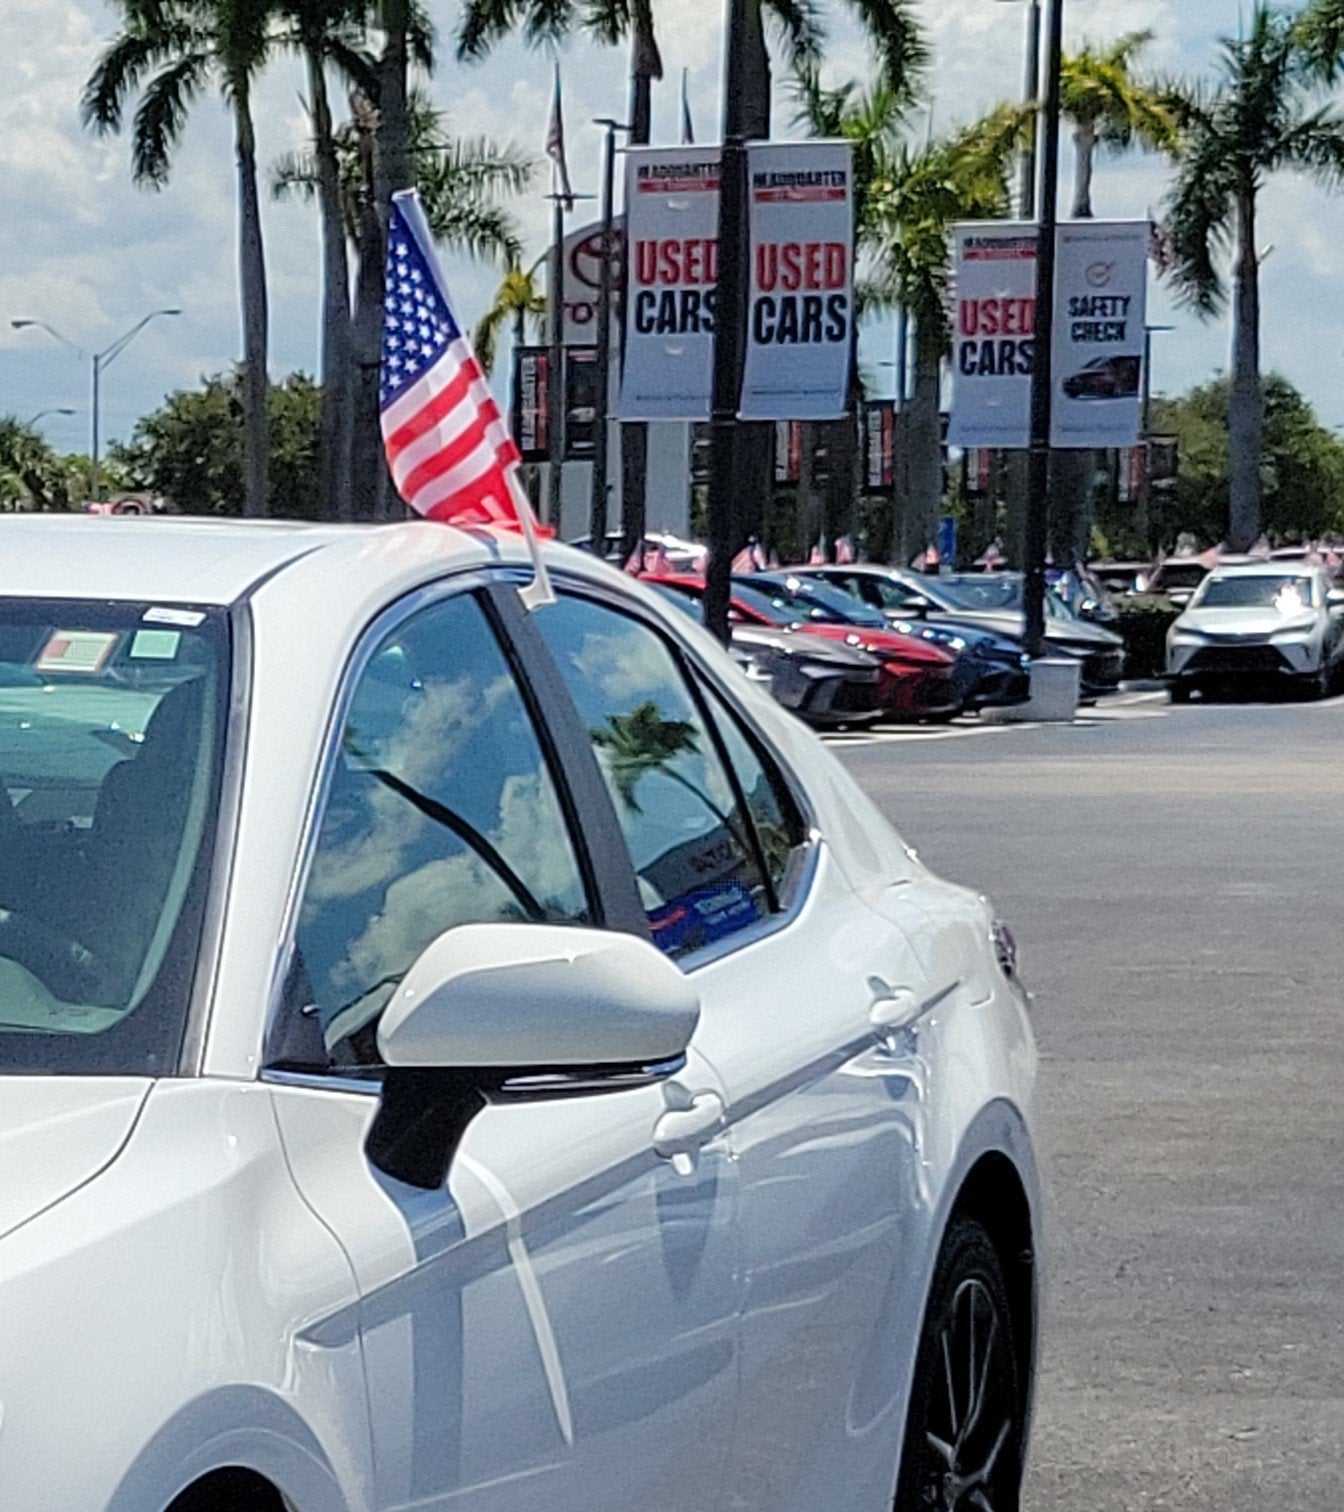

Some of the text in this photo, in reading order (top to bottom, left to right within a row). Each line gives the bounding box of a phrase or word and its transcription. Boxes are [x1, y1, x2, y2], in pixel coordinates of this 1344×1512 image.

[636, 238, 718, 286] USED
[756, 242, 846, 293] USED
[635, 290, 717, 334] CARS
[753, 294, 848, 345] CARS
[1068, 296, 1131, 318] SAFETY
[1071, 321, 1127, 342] CHECK
[959, 340, 1035, 376] CARS
